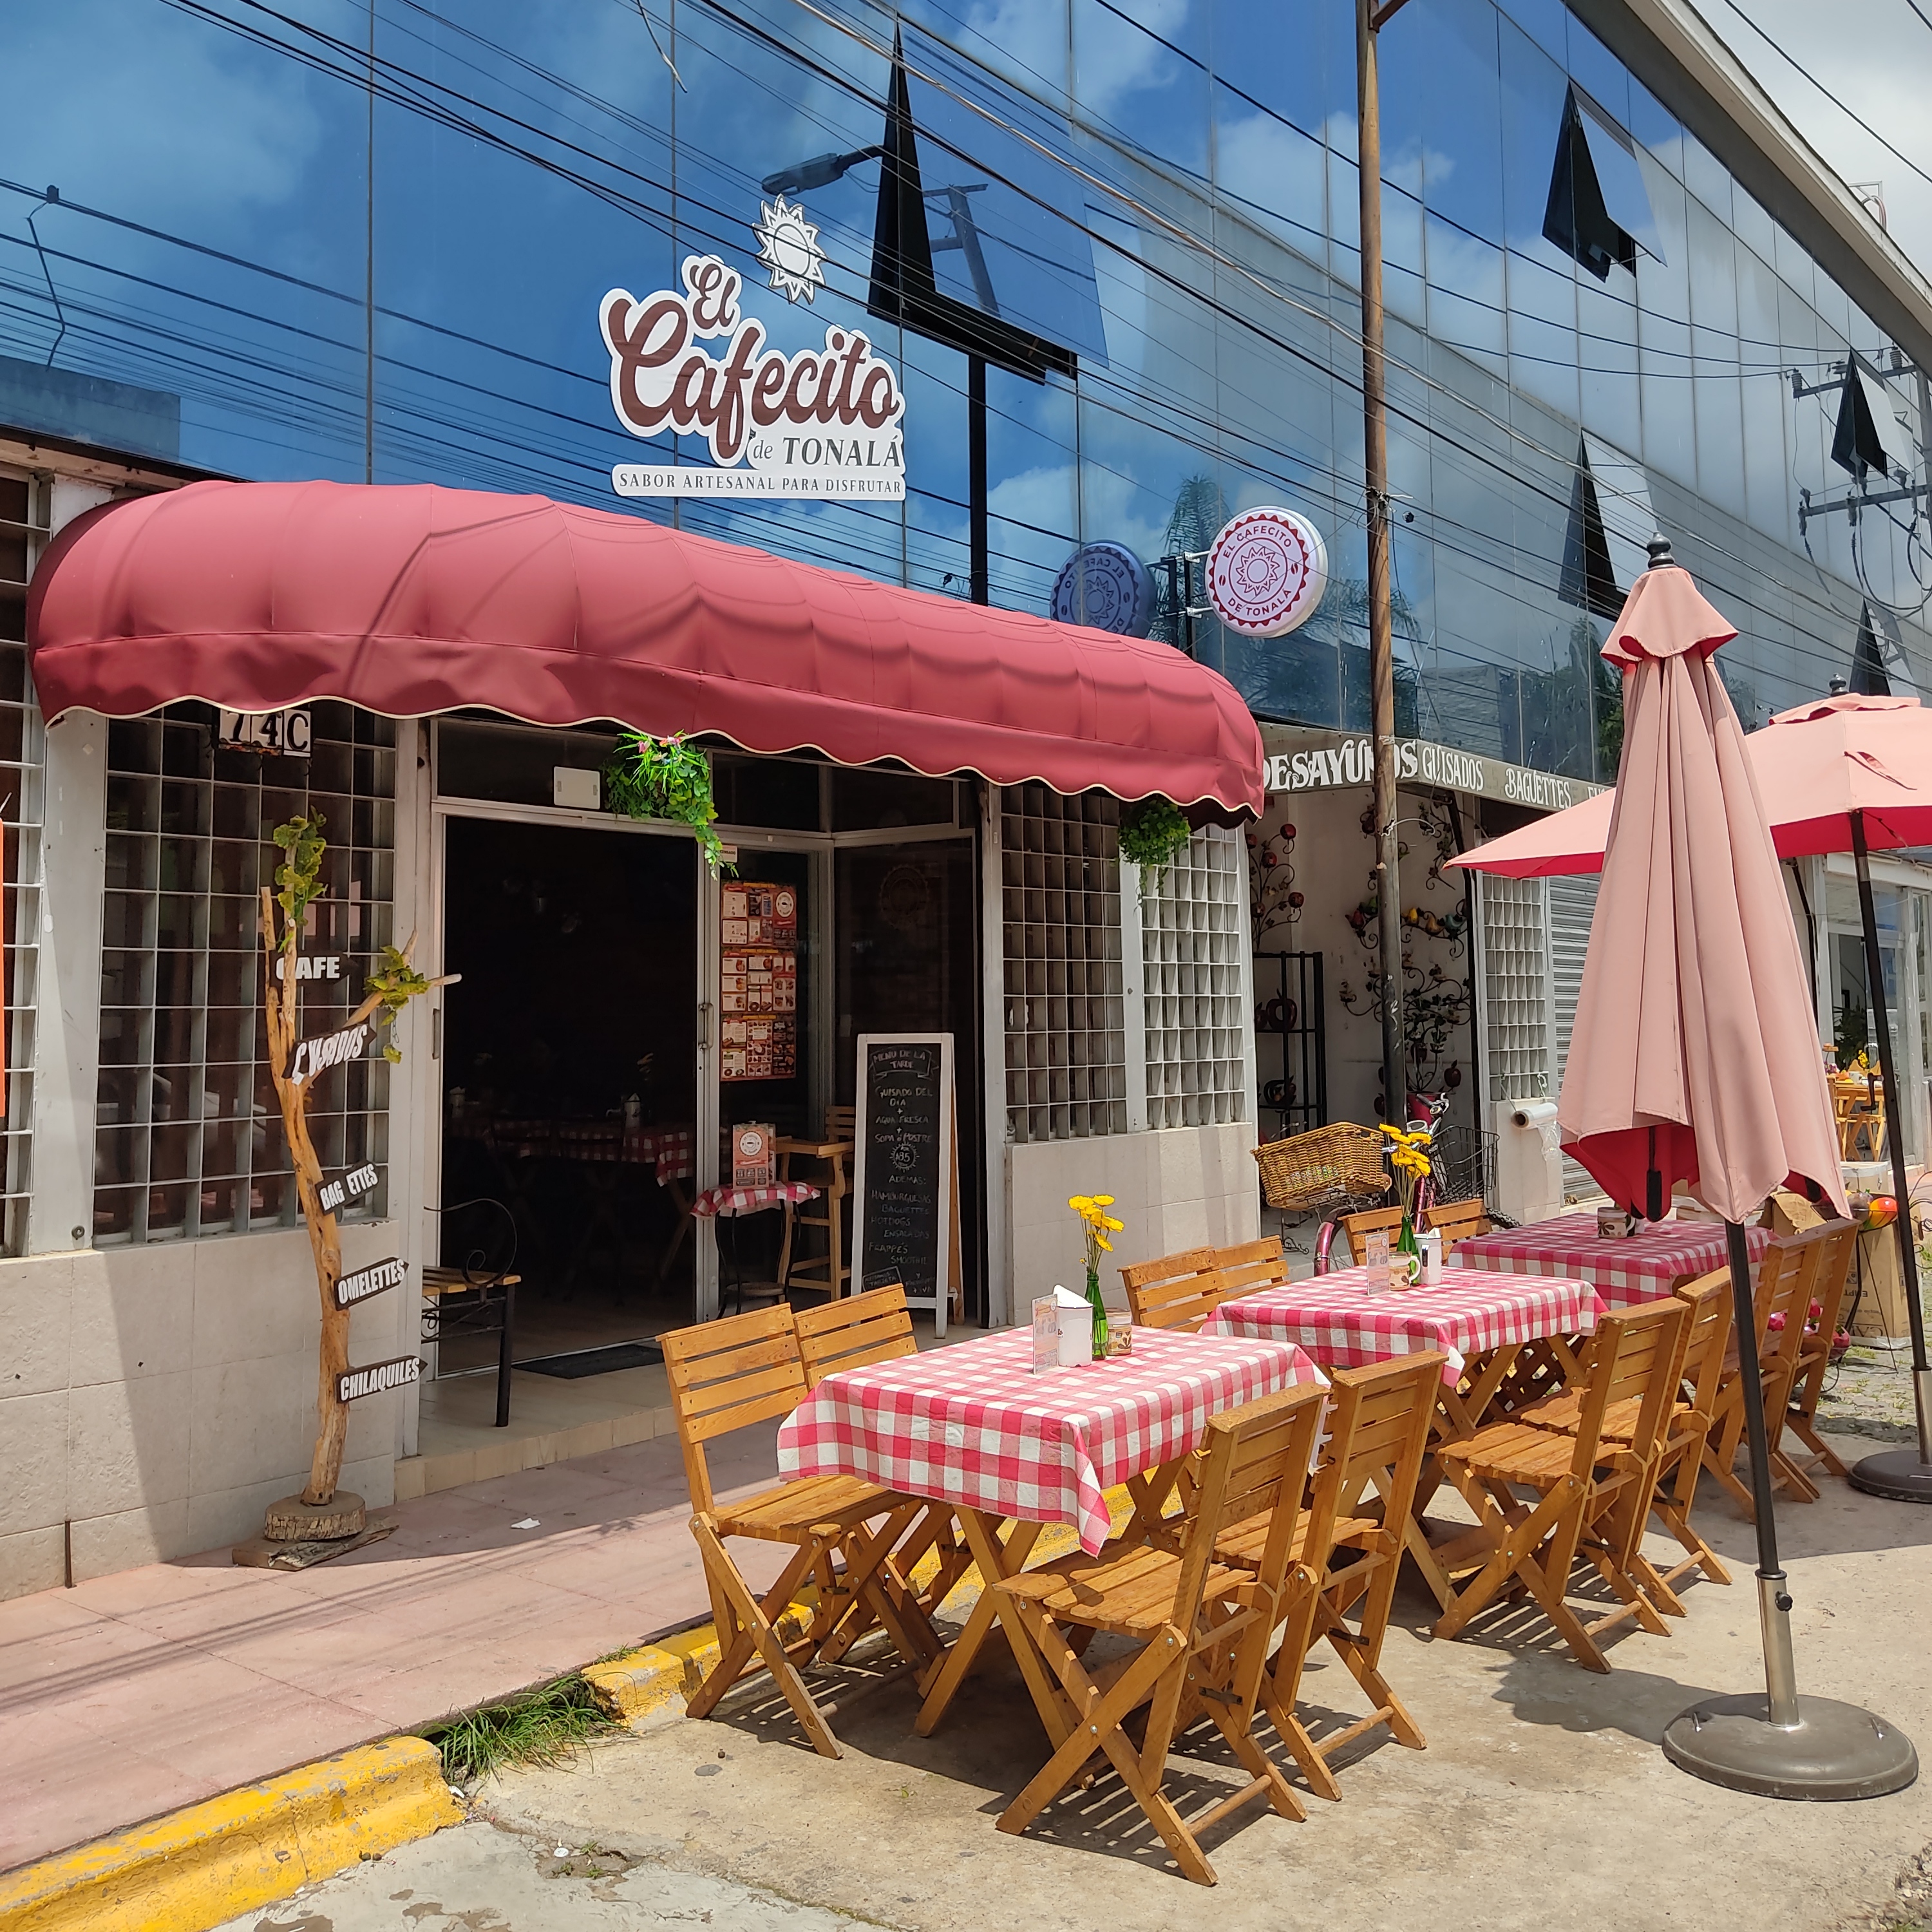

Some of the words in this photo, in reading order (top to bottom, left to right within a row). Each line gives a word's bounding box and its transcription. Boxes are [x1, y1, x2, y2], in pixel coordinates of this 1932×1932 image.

[690, 263, 735, 330] El
[608, 299, 900, 459] Cafecito
[753, 440, 773, 460] de
[782, 434, 900, 468] TONALÁ
[620, 473, 675, 488] SABOR
[683, 475, 775, 490] ARTESANAL
[782, 477, 819, 491] PARA
[825, 478, 901, 493] DISFRUTAR
[1223, 545, 1235, 558] EL
[1236, 526, 1291, 547] CAFECITO
[1227, 597, 1243, 612] DE
[1246, 588, 1292, 616] TONALÁ
[1263, 739, 1418, 791] ESAYUS
[1422, 744, 1484, 791] GUISADOS
[1504, 767, 1571, 810] BAGUETTES
[337, 1258, 405, 1305] OMELETTES
[339, 1356, 420, 1402] CHILAQUILES
